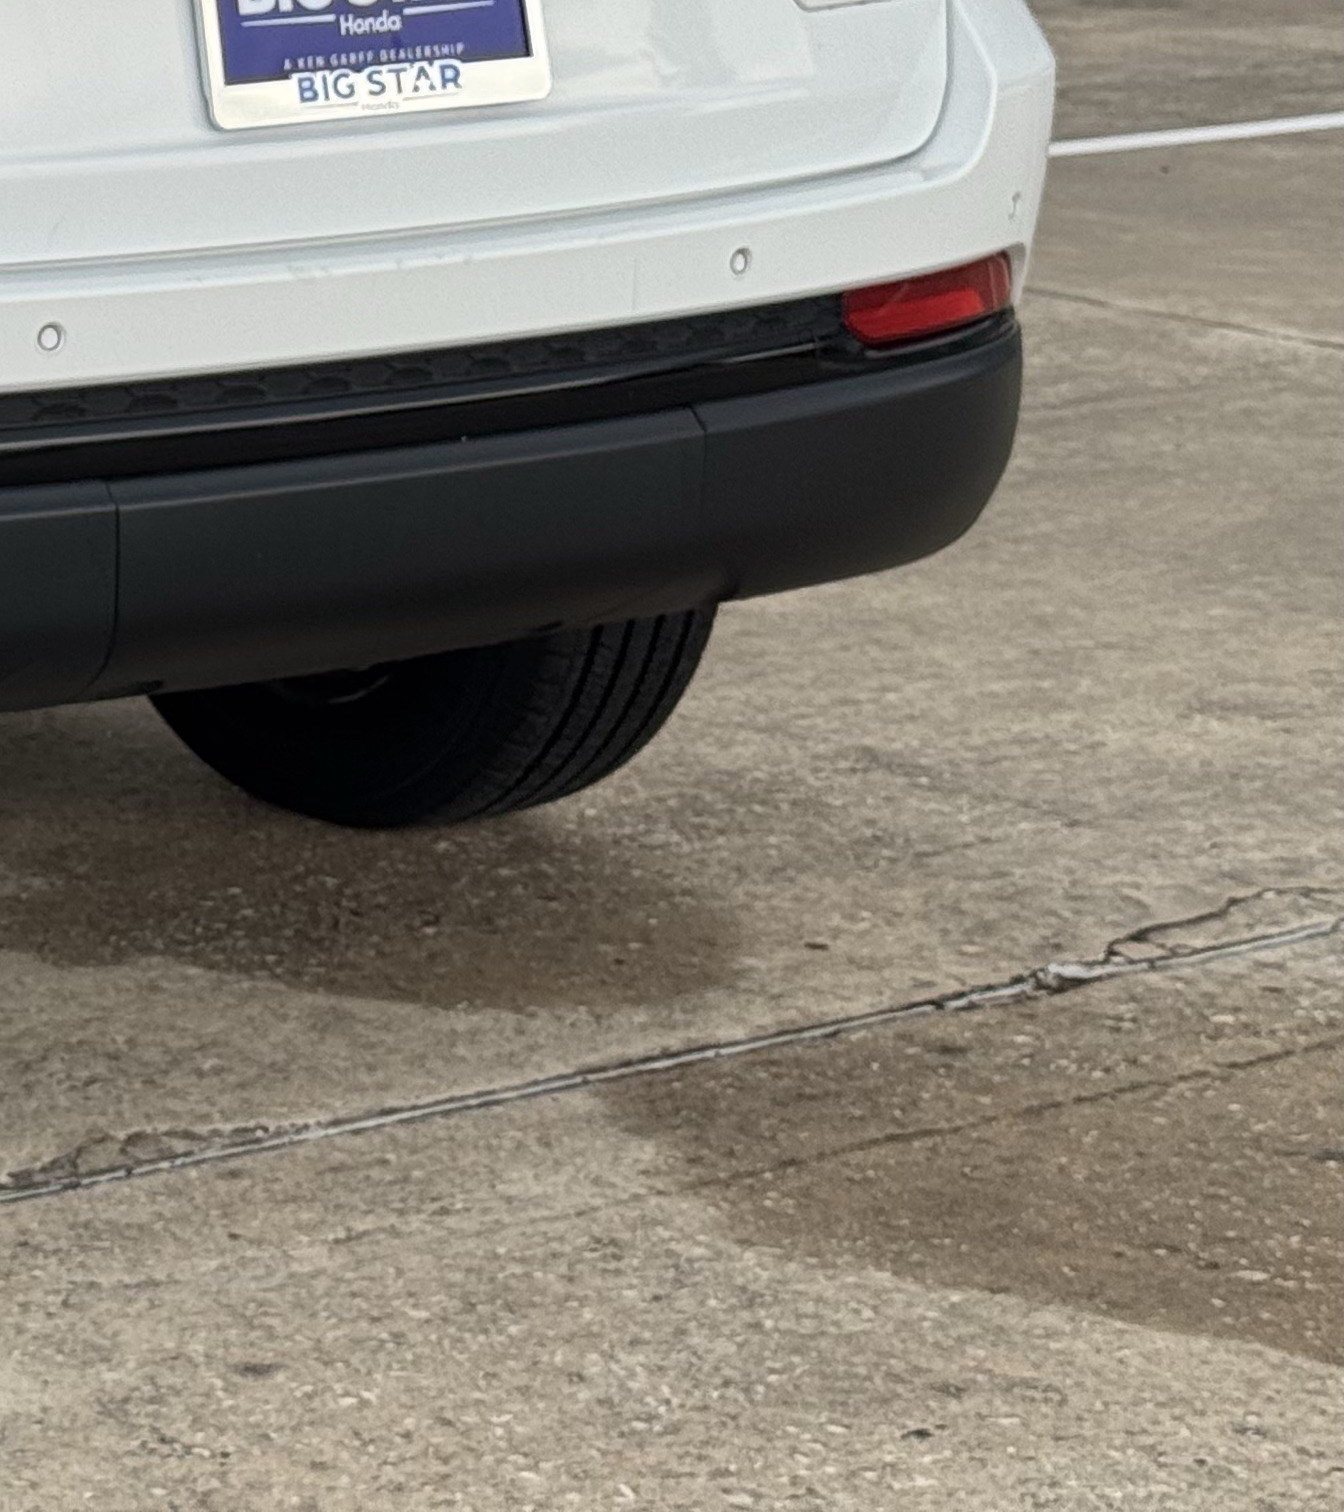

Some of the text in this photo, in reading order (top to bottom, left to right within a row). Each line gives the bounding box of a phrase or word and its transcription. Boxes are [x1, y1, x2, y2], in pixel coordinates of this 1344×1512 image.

[338, 10, 402, 36] Honda
[379, 41, 465, 63] DEALERSHIP
[297, 63, 463, 104] BIG STAR
